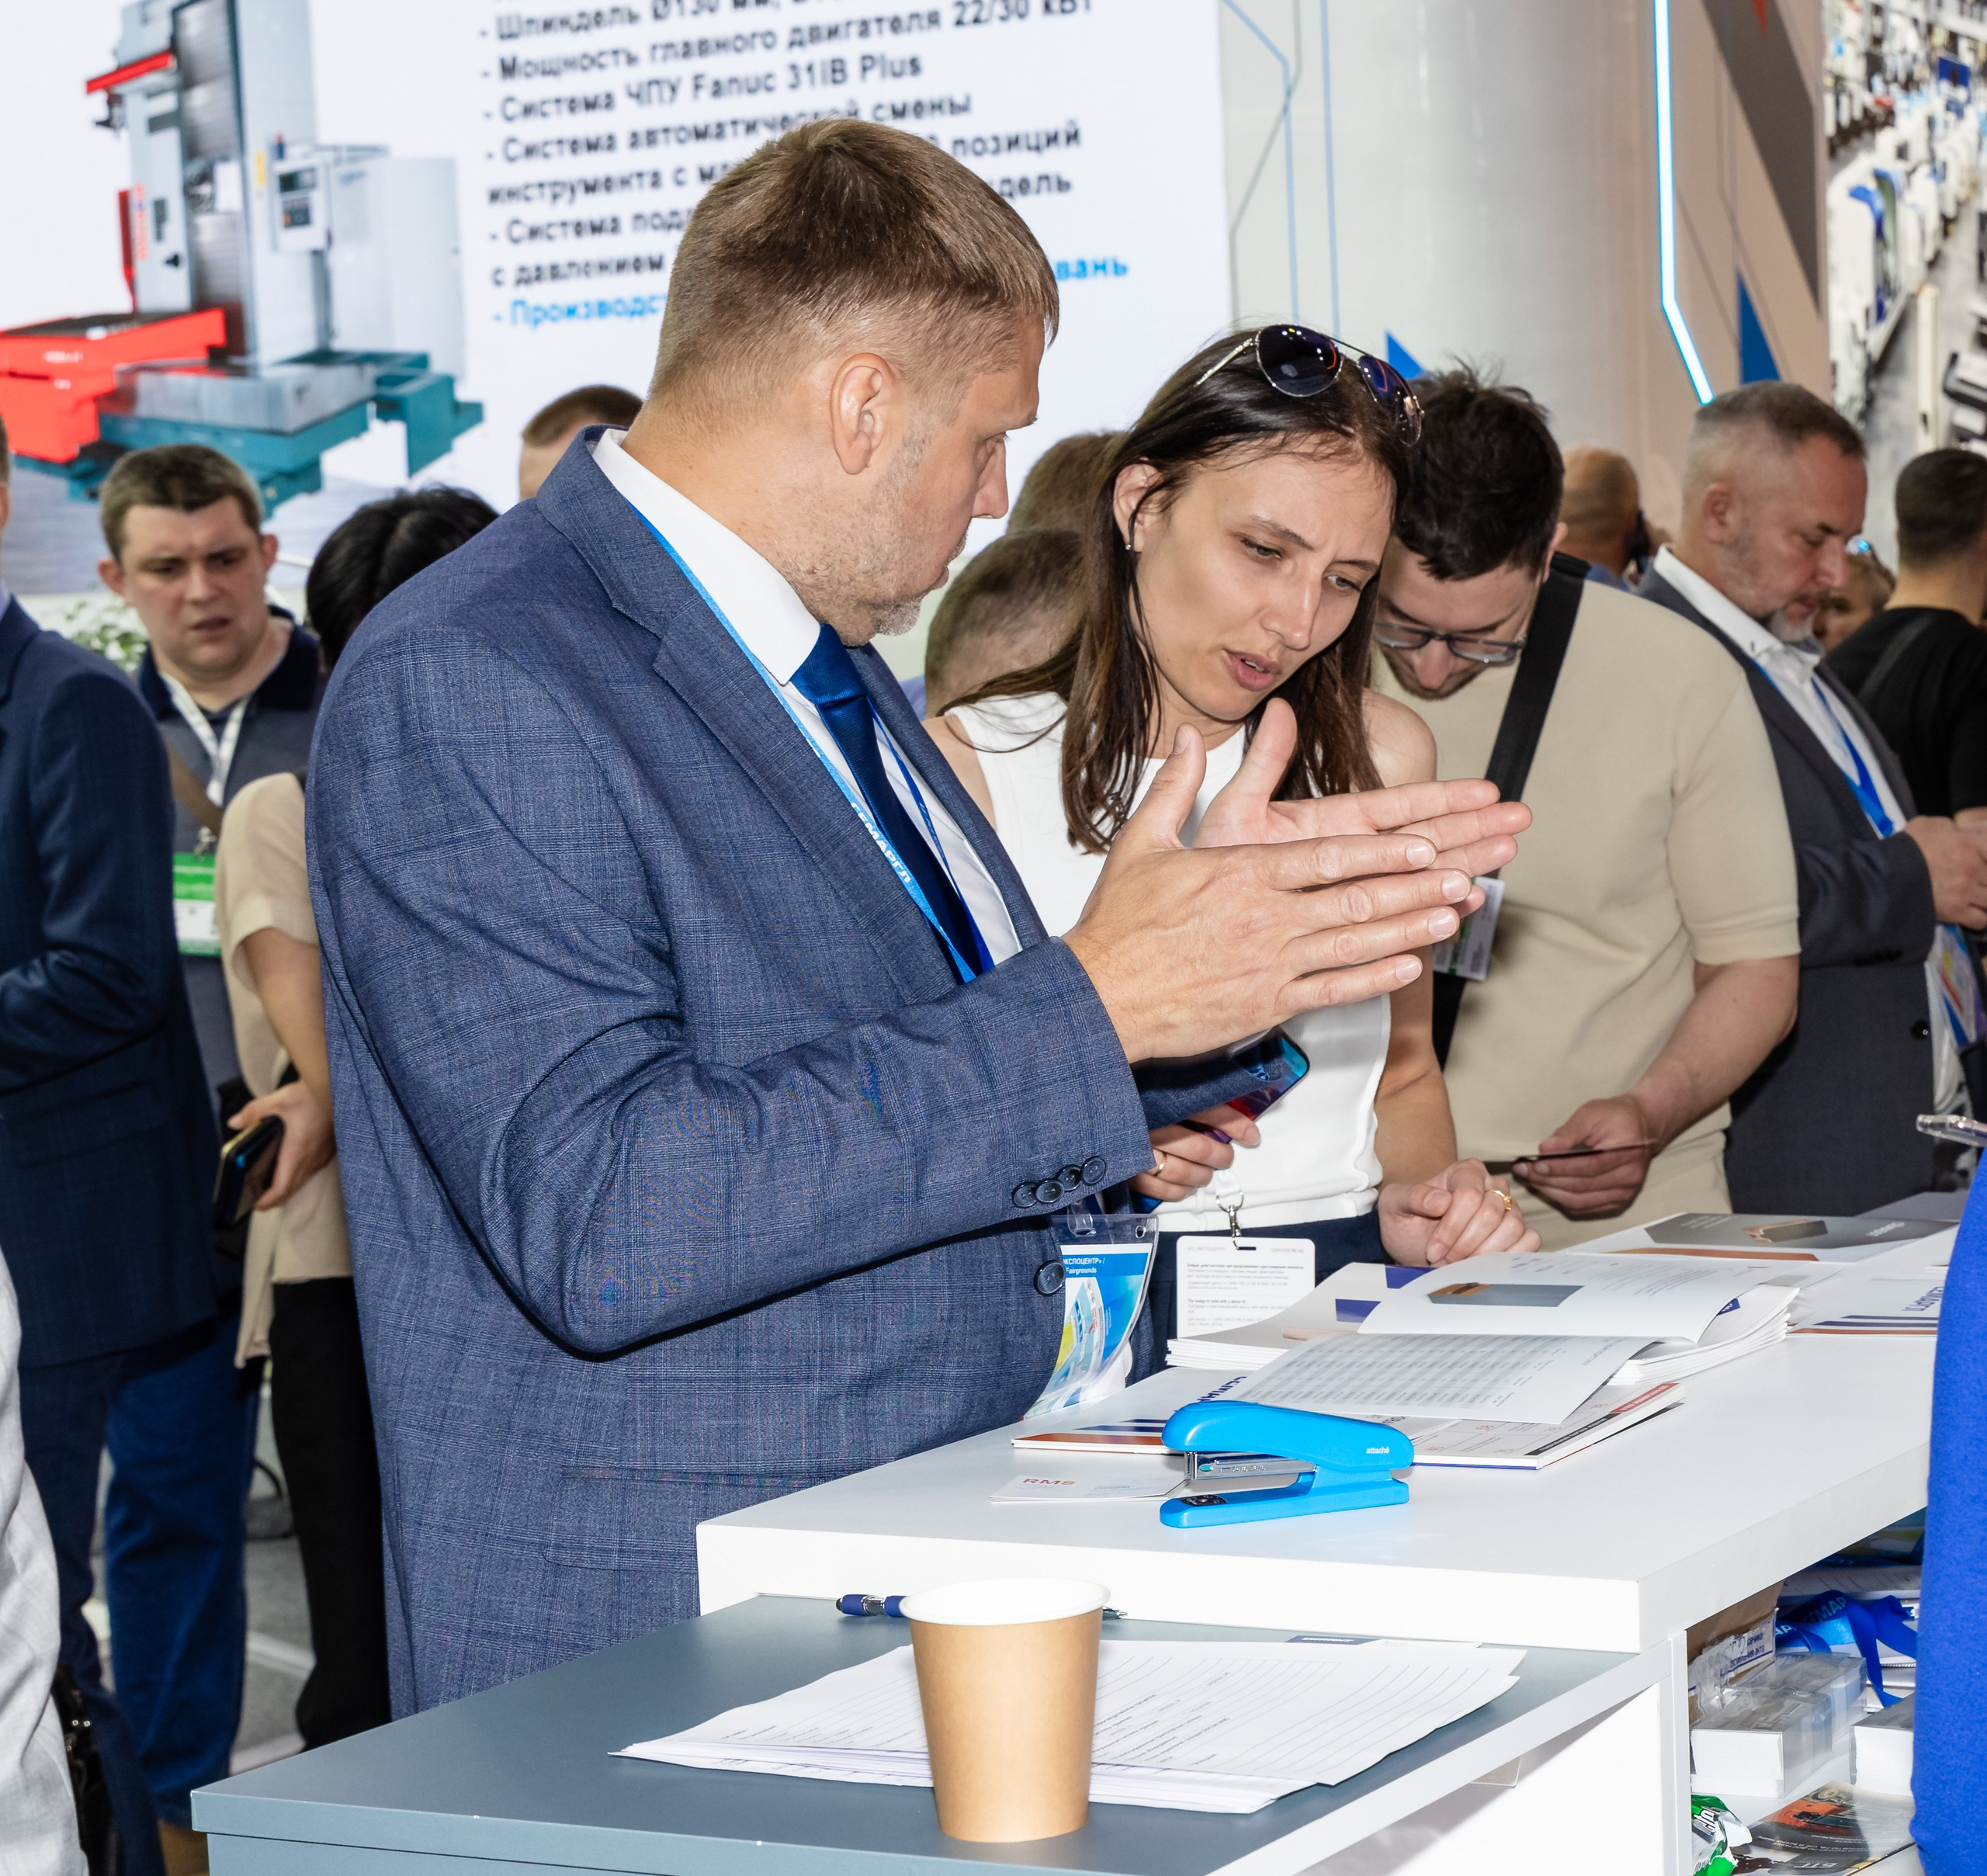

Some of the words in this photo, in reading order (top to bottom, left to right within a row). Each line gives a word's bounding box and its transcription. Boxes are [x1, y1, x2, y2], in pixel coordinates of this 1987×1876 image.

[496, 6, 641, 41] Шпиндель
[498, 48, 640, 81] Мощность
[650, 29, 778, 63] главного
[786, 9, 941, 51] двигателя
[953, 0, 1030, 28] 22/30
[500, 91, 616, 123] Система
[626, 78, 681, 106] ЧПУ
[692, 72, 776, 100] Fanuc
[859, 54, 923, 81] Plus
[487, 168, 663, 206] инструмента
[950, 119, 1081, 158] позиций
[502, 132, 618, 164] Система
[872, 95, 972, 122] смены
[506, 215, 622, 245] Система
[997, 172, 1073, 200] дель
[510, 293, 668, 328] Производс
[1056, 256, 1129, 284] вань
[513, 253, 665, 288] давлением
[1366, 1446, 1390, 1455] attaché
